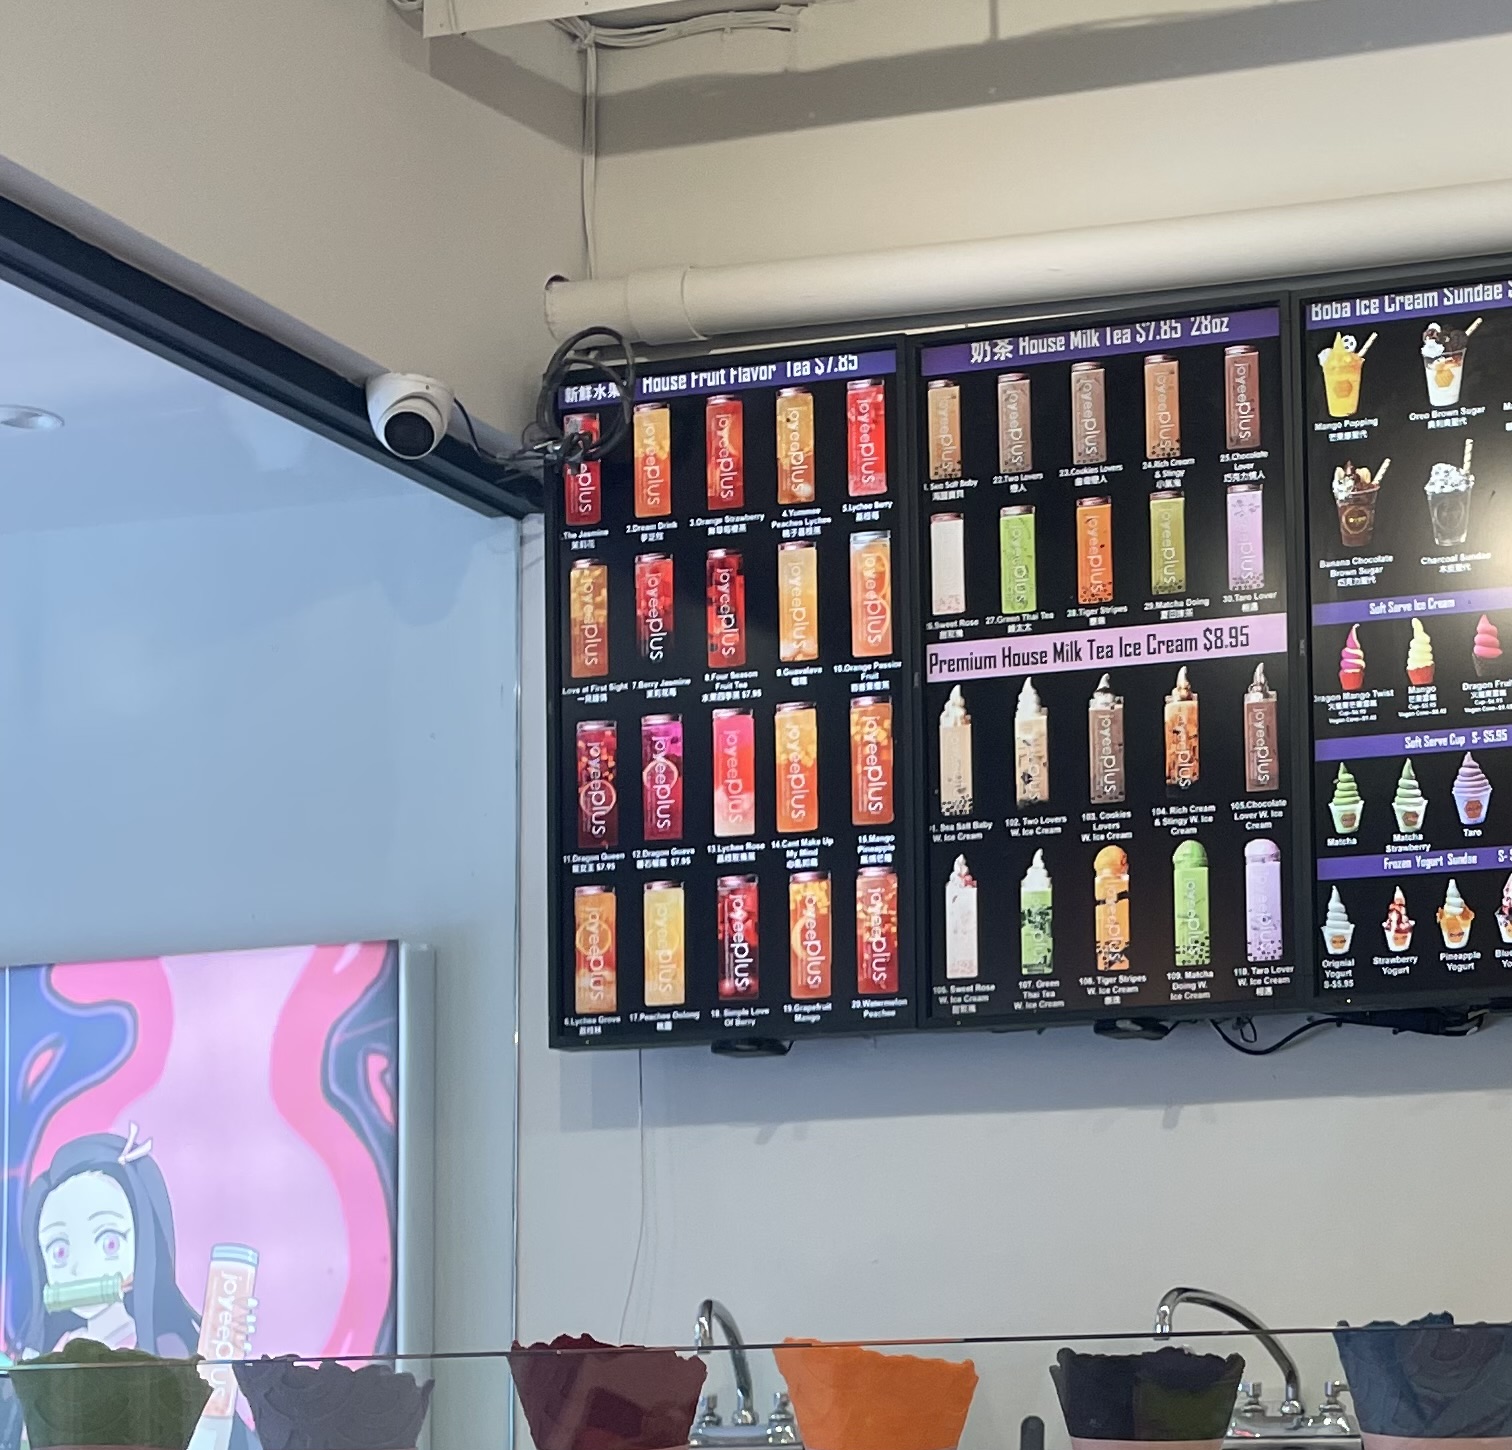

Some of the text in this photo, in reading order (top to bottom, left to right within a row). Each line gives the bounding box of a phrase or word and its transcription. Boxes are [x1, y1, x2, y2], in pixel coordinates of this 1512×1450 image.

[1356, 296, 1380, 315] Ice
[1384, 292, 1438, 312] Cream
[1444, 284, 1503, 306] Sundae
[1019, 334, 1064, 355] House
[1070, 330, 1100, 350] Milk
[1105, 325, 1132, 346] Tea
[1135, 319, 1181, 343] $7.85
[929, 625, 1250, 674] Premium House Milk Tea Ice Cream $8.95
[212, 1272, 242, 1400] joyeepus
